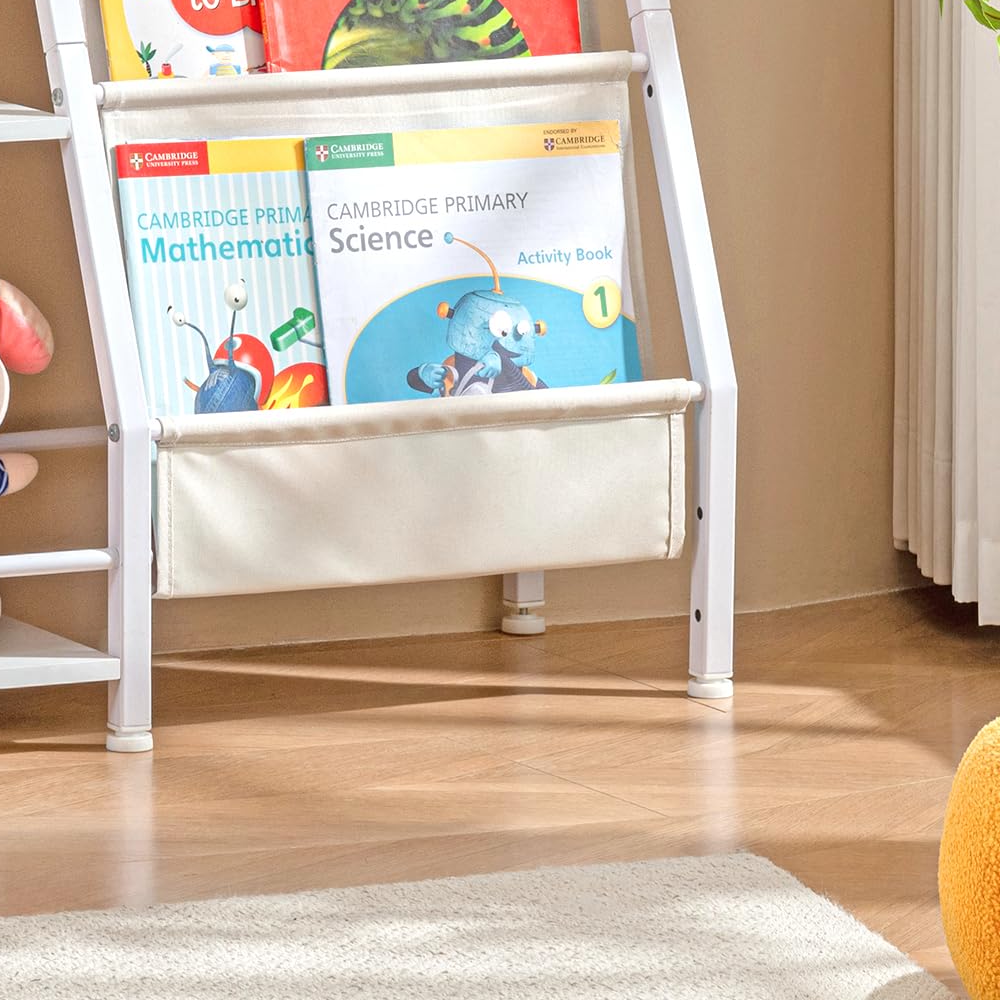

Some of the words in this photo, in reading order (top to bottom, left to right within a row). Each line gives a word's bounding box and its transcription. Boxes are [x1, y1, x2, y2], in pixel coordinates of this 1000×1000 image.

[330, 142, 384, 154] CAMBRIDGE
[556, 136, 605, 145] CAMBRIDGE
[145, 151, 198, 162] CAMBRIDGE
[327, 197, 438, 220] CAMBRIDGE
[445, 192, 528, 213] PRIMARY
[137, 208, 249, 230] CAMBRIDGE
[329, 225, 433, 253] Science
[517, 248, 571, 266] Activity
[576, 246, 613, 261] Book
[594, 286, 608, 317] 1
